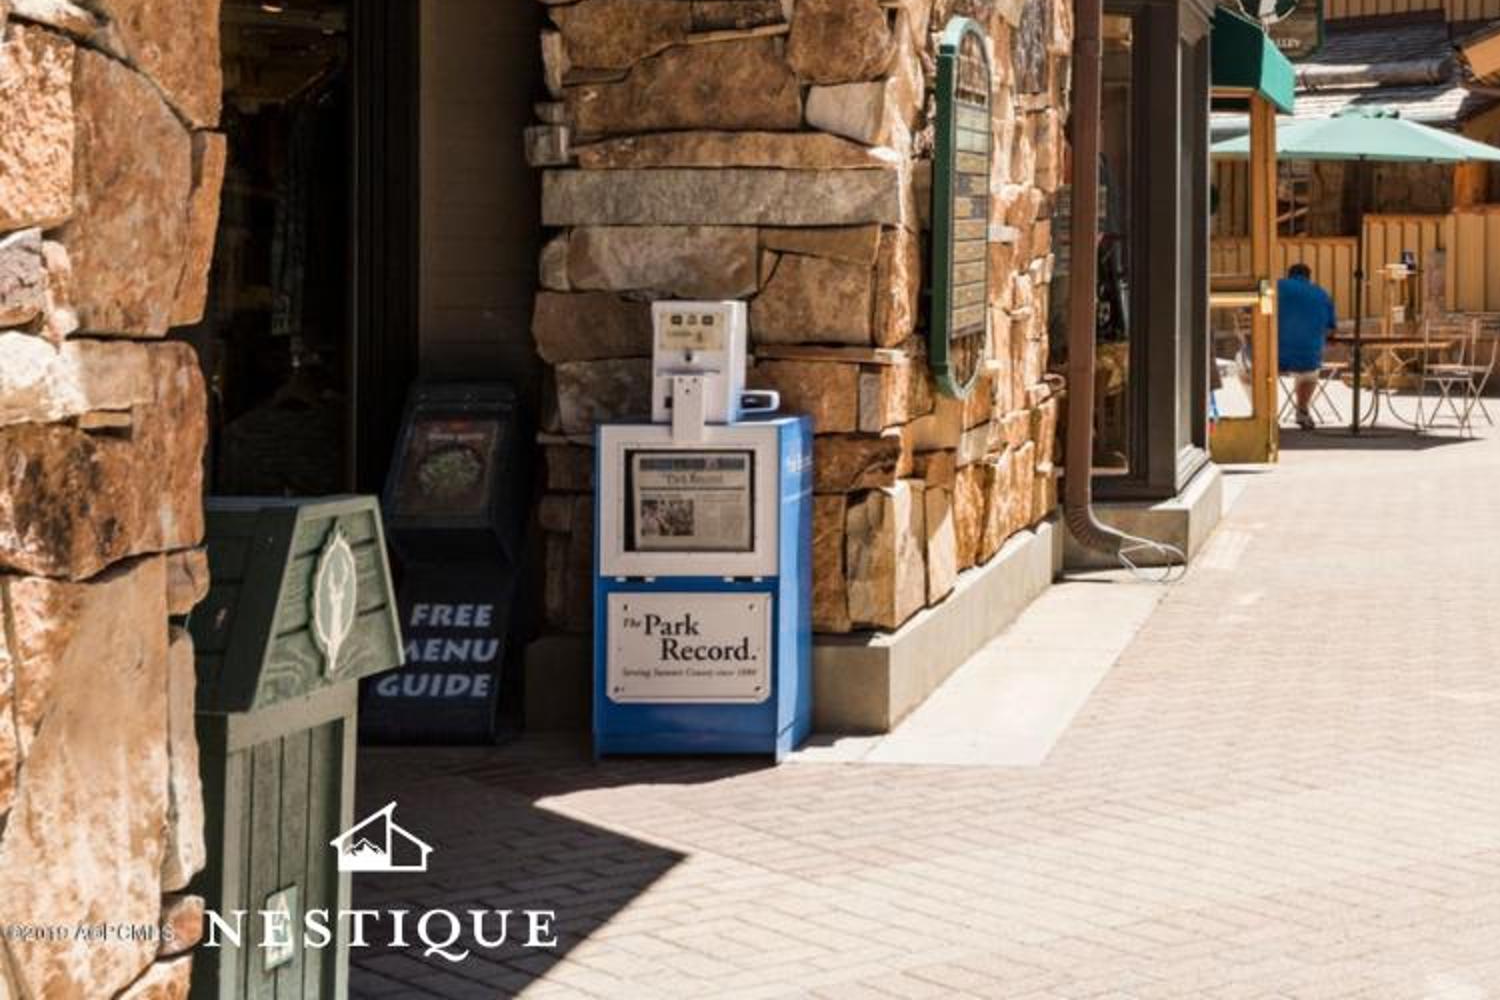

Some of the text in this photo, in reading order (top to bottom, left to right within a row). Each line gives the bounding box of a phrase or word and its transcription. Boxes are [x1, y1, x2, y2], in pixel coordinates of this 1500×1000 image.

[409, 603, 494, 627] FREE
[623, 612, 699, 636] The Park
[659, 636, 757, 661] Record.
[376, 673, 492, 697] GUIDE
